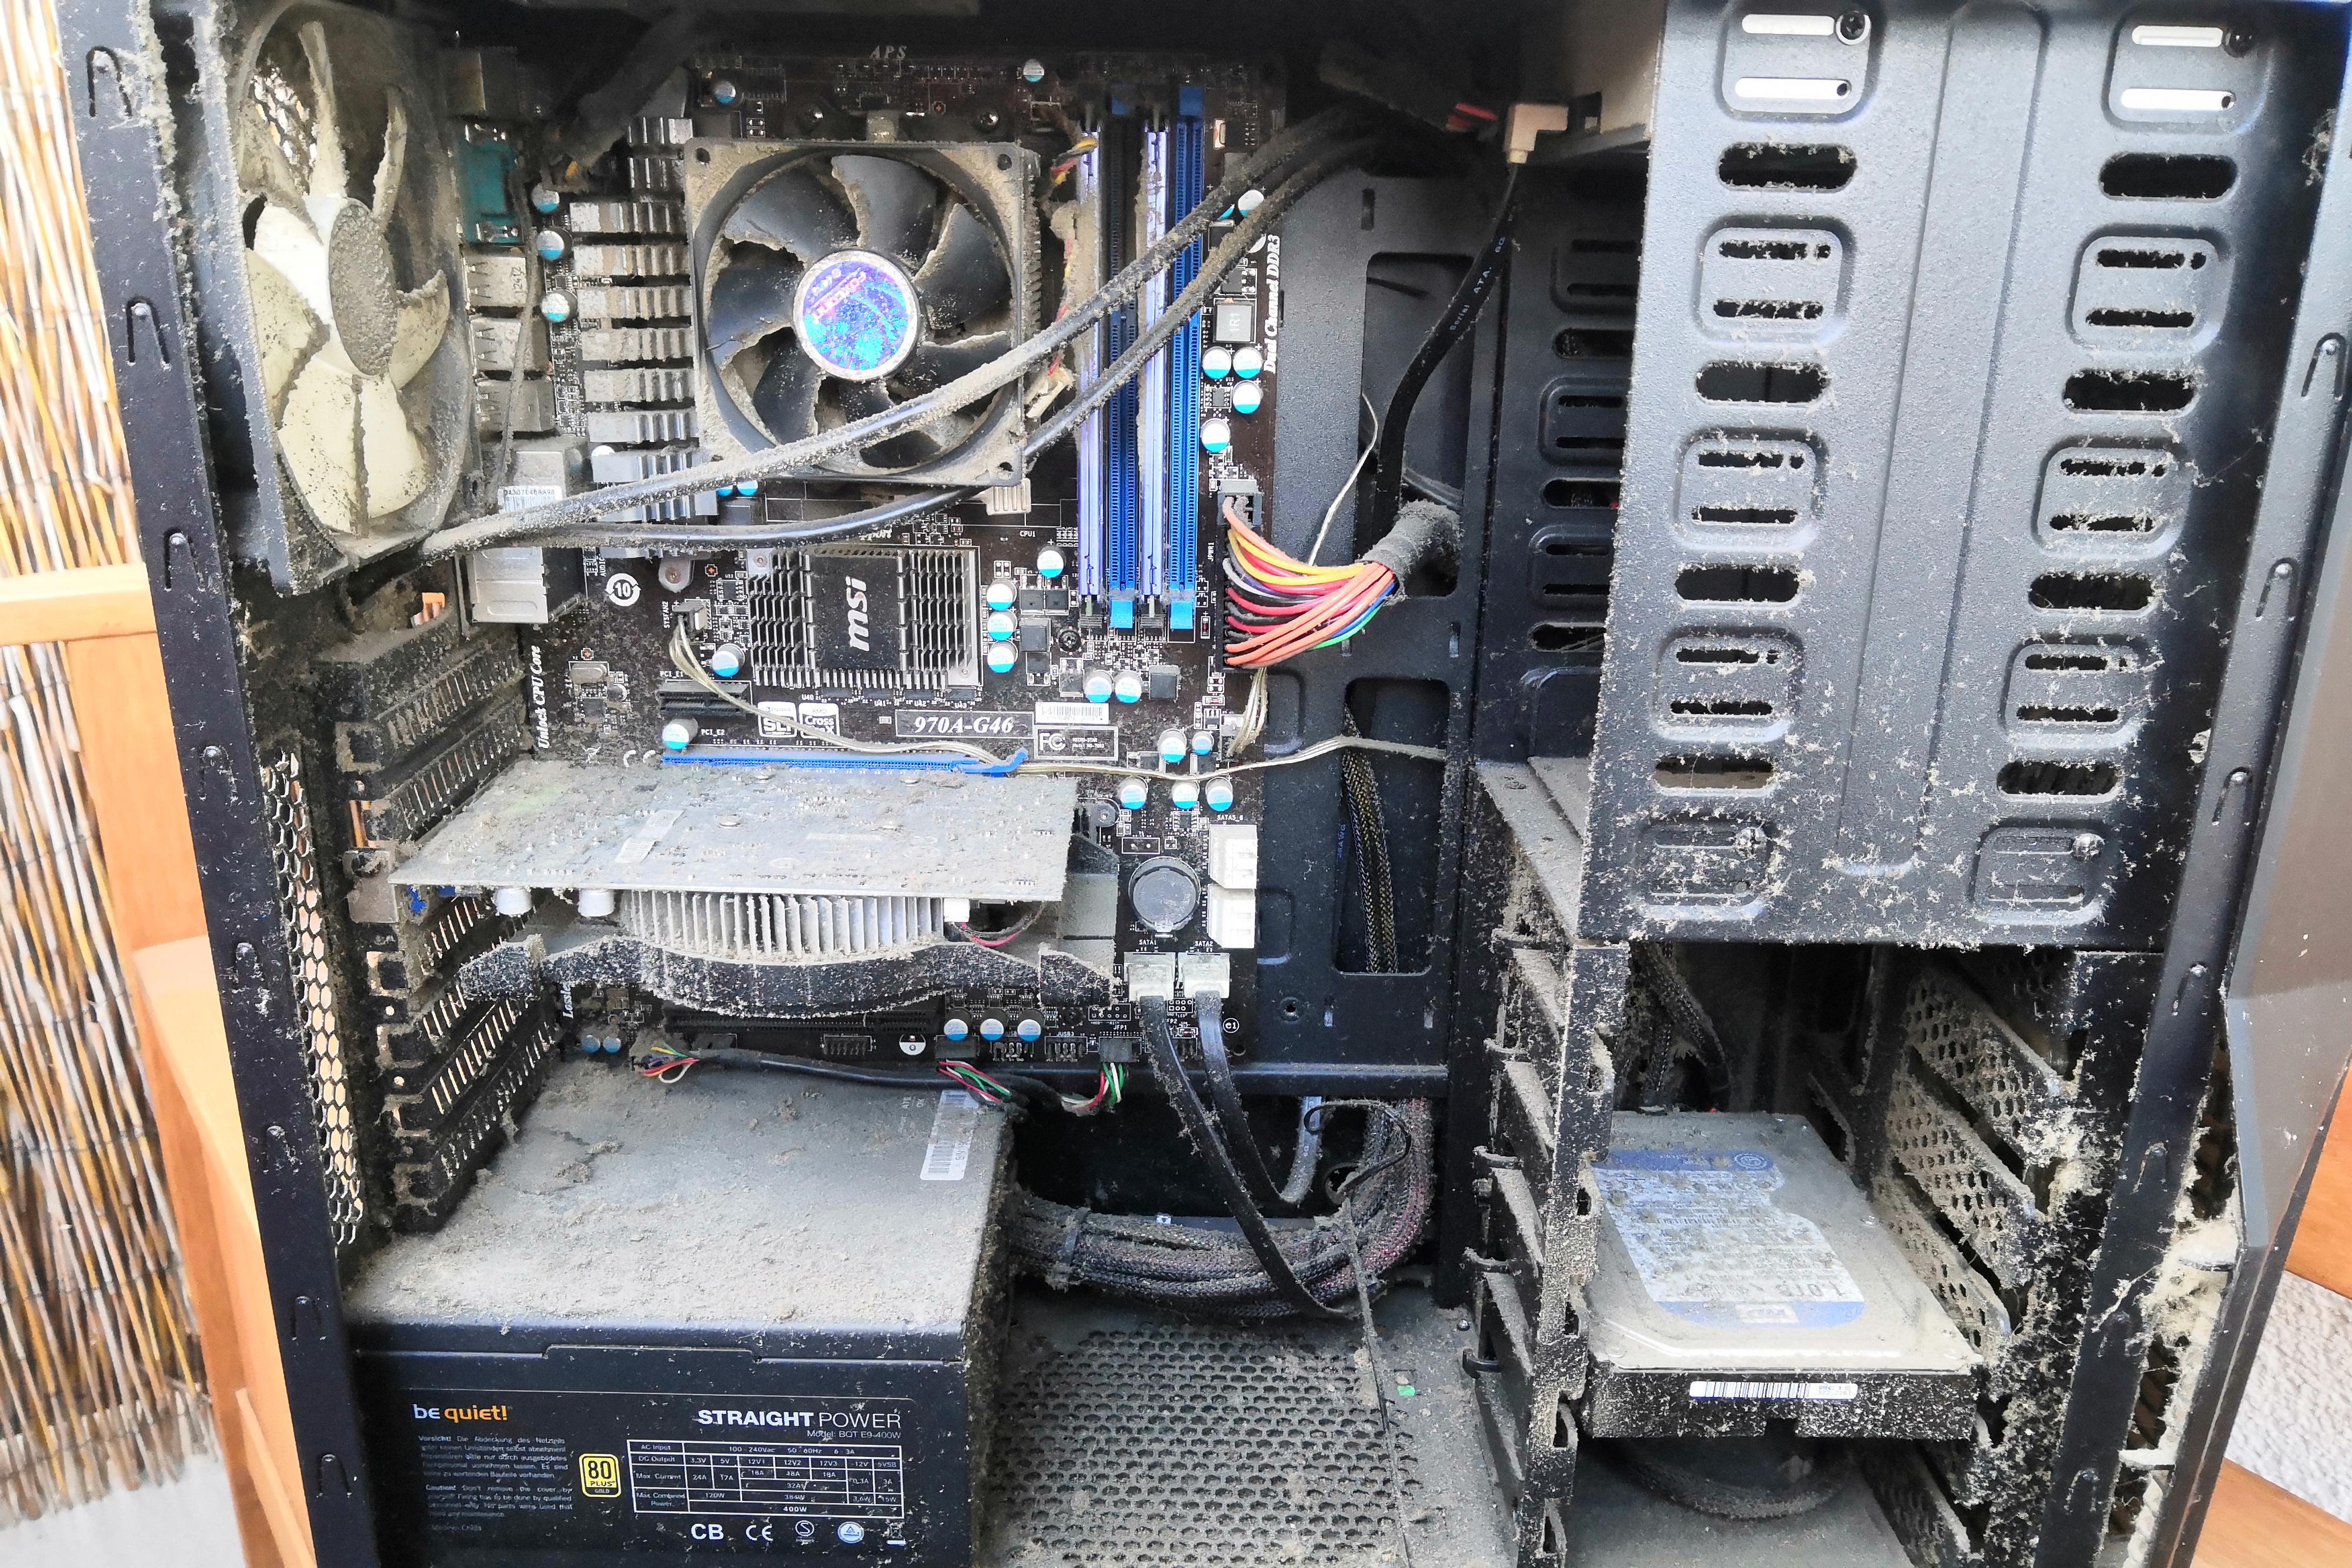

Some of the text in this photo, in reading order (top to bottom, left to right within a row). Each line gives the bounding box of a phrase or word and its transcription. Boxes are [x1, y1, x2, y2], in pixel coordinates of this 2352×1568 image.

[870, 45, 907, 59] APS
[1264, 234, 1280, 374] Dual Channel DDR3
[614, 582, 631, 597] 10
[662, 601, 670, 628] SYSFAN2
[530, 645, 550, 749] Unlock CPU Core
[805, 716, 834, 726] Cross
[914, 717, 1014, 733] 970A-G46
[560, 984, 574, 1019] Lossle
[413, 1404, 508, 1423] be quiet!
[699, 1410, 901, 1429] STRAIGHT POWER
[588, 1460, 612, 1479] 80
[691, 1523, 724, 1540] CB
